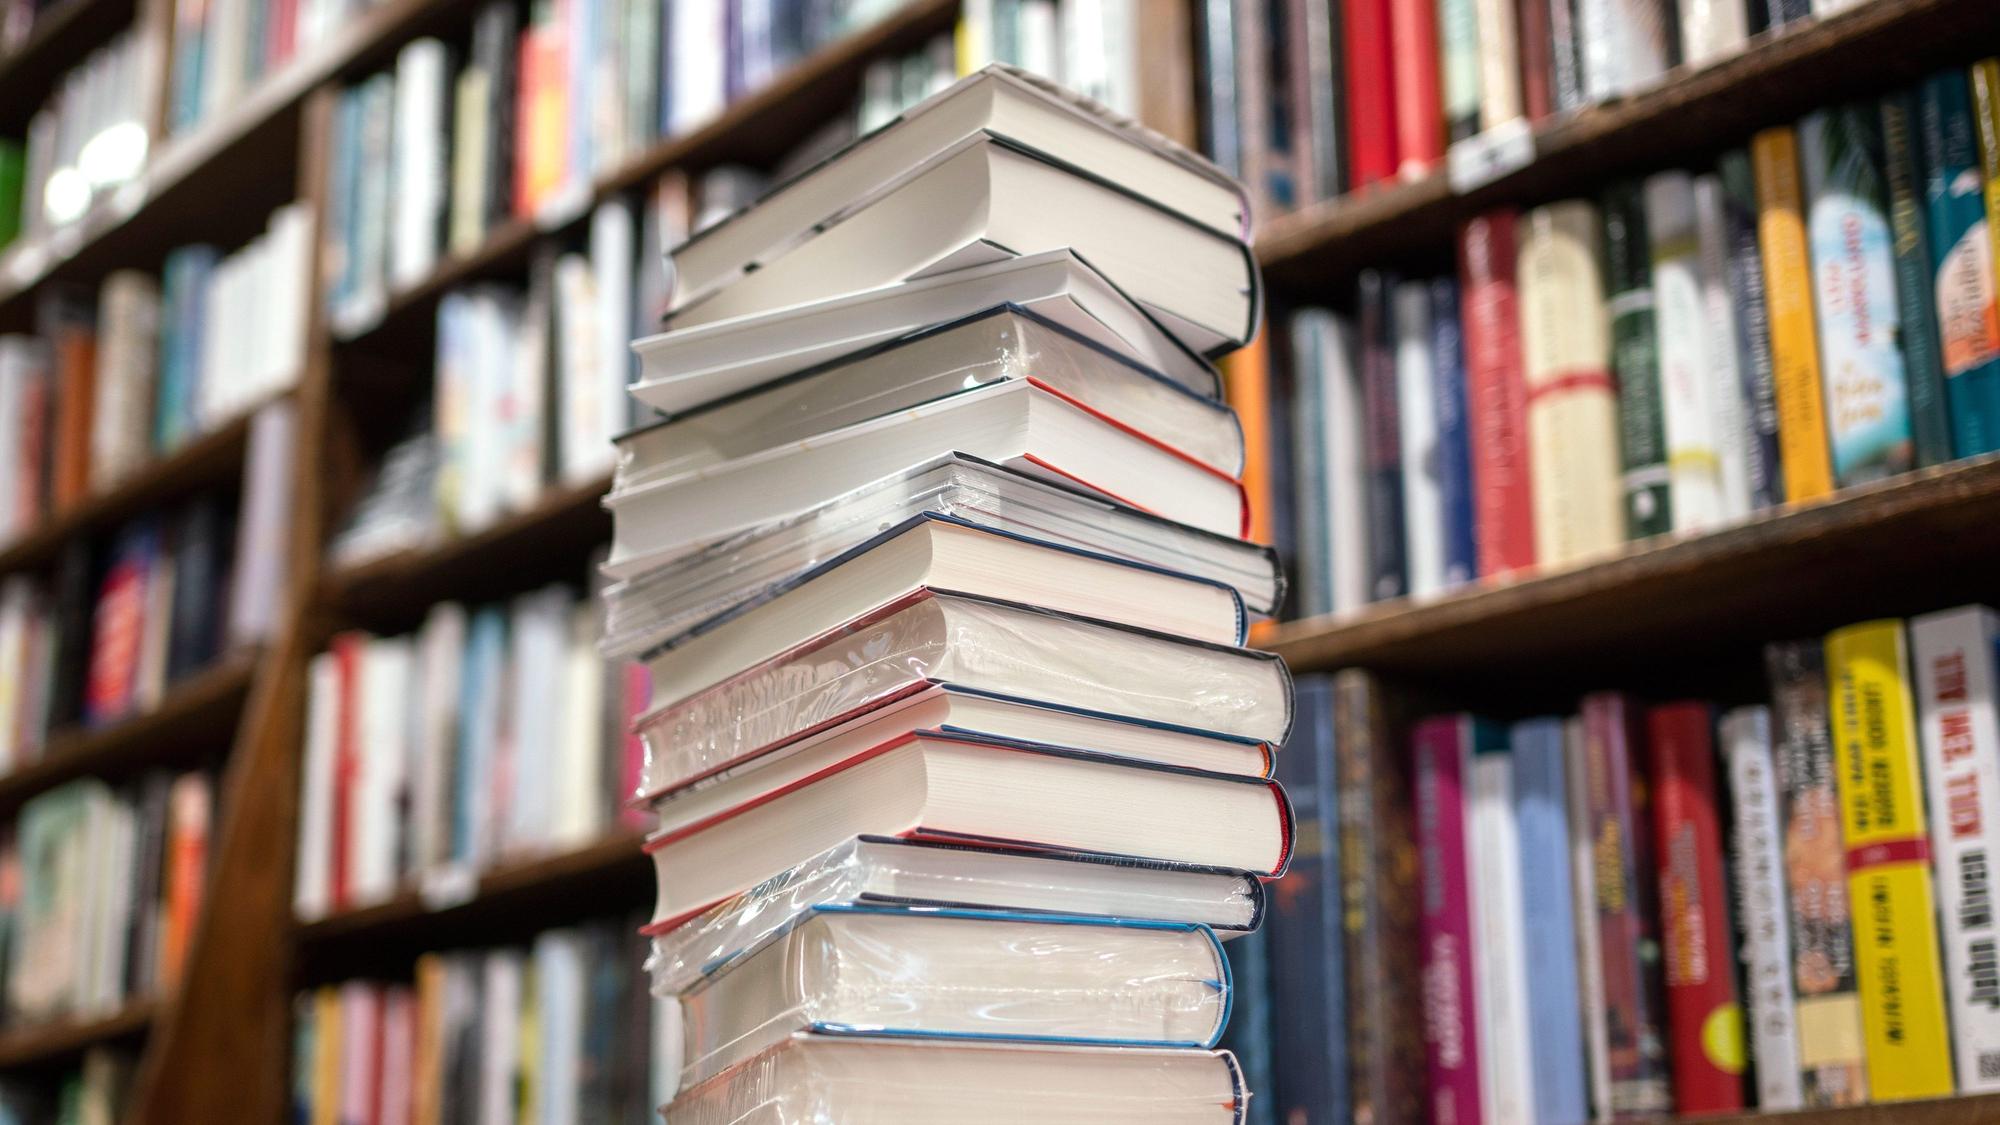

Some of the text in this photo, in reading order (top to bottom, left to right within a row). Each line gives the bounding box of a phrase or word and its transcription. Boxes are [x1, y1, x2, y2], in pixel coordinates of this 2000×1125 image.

[1947, 770, 1981, 840] KILL
[1958, 852, 2000, 1010] John Niven
